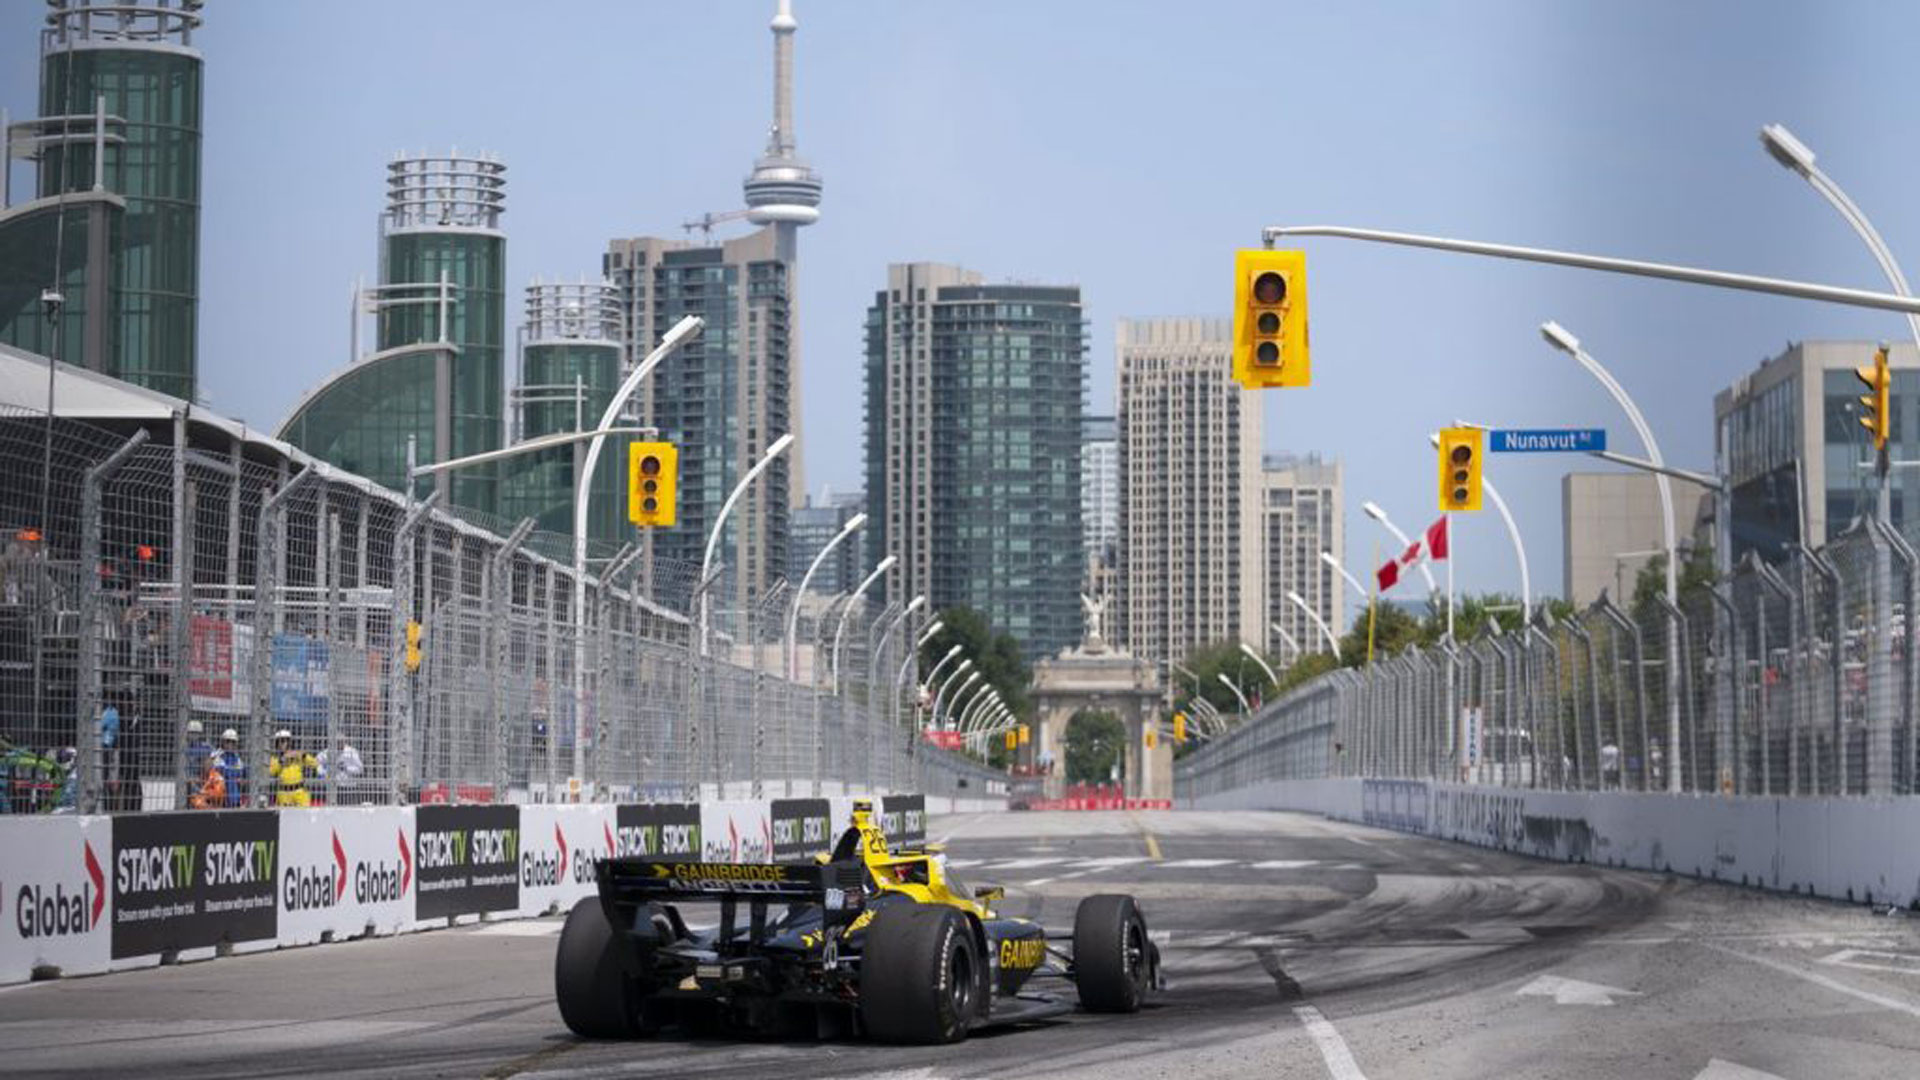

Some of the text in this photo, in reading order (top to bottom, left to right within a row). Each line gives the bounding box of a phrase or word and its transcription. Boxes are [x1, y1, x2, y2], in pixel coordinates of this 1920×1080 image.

[1505, 431, 1577, 449] Nunavut
[205, 840, 274, 886] STACKTV
[419, 830, 467, 869] STACKTV
[472, 828, 517, 865] STACKTV
[117, 844, 195, 894] STACKTV
[284, 863, 335, 912] Global
[355, 859, 402, 904] Global
[522, 851, 560, 887] Global
[675, 864, 786, 881] GAINBRIDGE
[17, 881, 89, 939] Global
